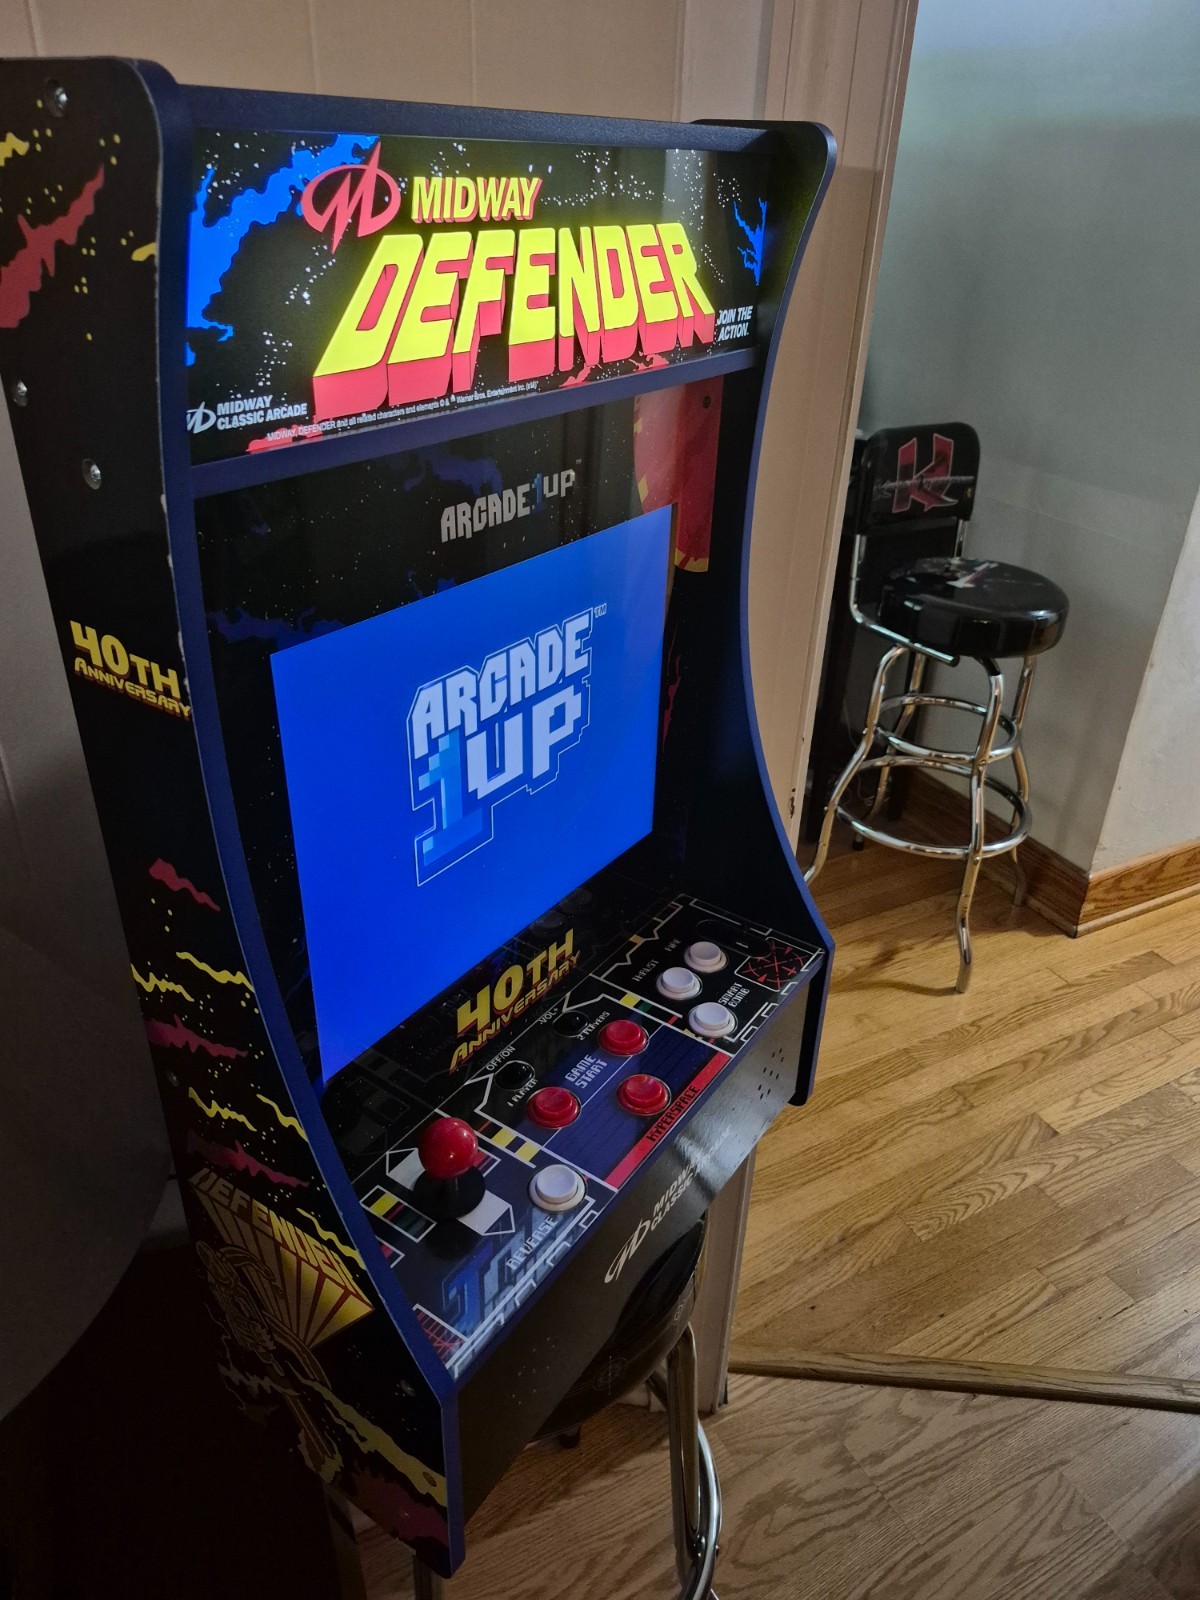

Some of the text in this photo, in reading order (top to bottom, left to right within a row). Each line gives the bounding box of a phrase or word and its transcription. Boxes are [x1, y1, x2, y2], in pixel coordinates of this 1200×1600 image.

[411, 176, 542, 224] MIDWAY
[312, 222, 715, 416] DEFENDER
[717, 305, 753, 326] JOIN THE
[718, 322, 749, 341] ACTION.
[217, 395, 273, 416] MIDWAY
[217, 403, 308, 430] CLASSIC ARCADE
[267, 429, 298, 441] MIDWAY,
[299, 420, 336, 435] DEFENDER
[69, 620, 182, 702] 40TH
[73, 656, 192, 721] ANNIVERSARY
[412, 613, 590, 760] ARCADE
[418, 684, 582, 867] 1UP
[664, 938, 681, 952] FIRE
[456, 928, 574, 1037] 40TH
[632, 959, 660, 982] THRUST
[718, 982, 743, 1005] SMART
[728, 988, 750, 1008] BOMB
[449, 950, 580, 1076] ANNIVERSARY
[582, 1011, 611, 1036] PLAYERS
[486, 1045, 516, 1071] OFF/ON
[565, 1054, 596, 1083] GAME
[575, 1058, 608, 1089] START
[511, 1078, 539, 1103] PLAYER
[645, 1085, 700, 1142] HYPERSPACE
[650, 1172, 694, 1232] CLASSIC
[505, 1215, 558, 1270] REVERSE
